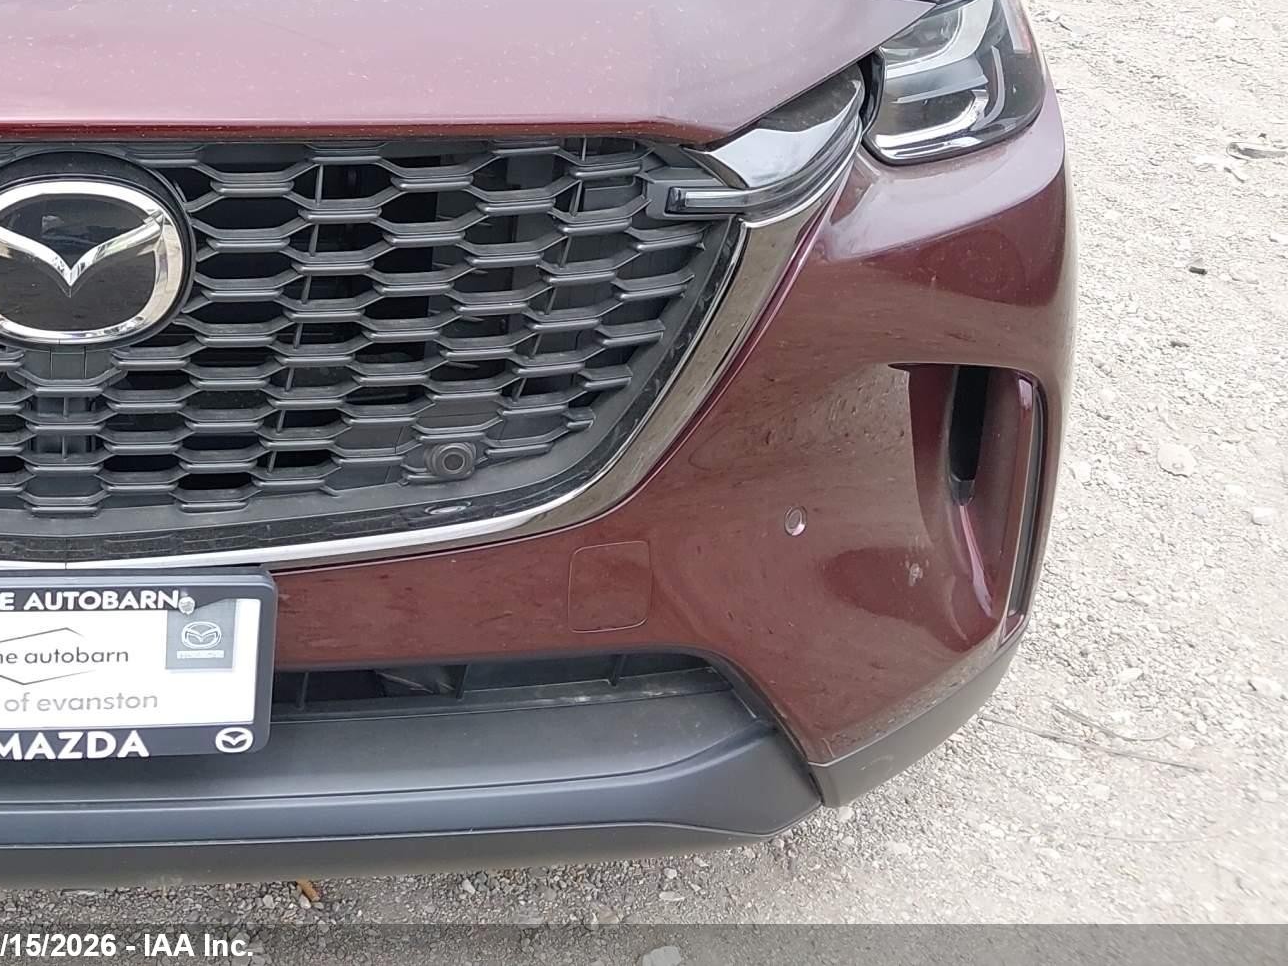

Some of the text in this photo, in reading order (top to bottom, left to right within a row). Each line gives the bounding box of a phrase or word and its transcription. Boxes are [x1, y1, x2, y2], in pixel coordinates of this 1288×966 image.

[24, 589, 180, 611] AUTOBARN
[24, 646, 130, 665] autobarn
[4, 691, 32, 713] of
[36, 690, 159, 713] evanston
